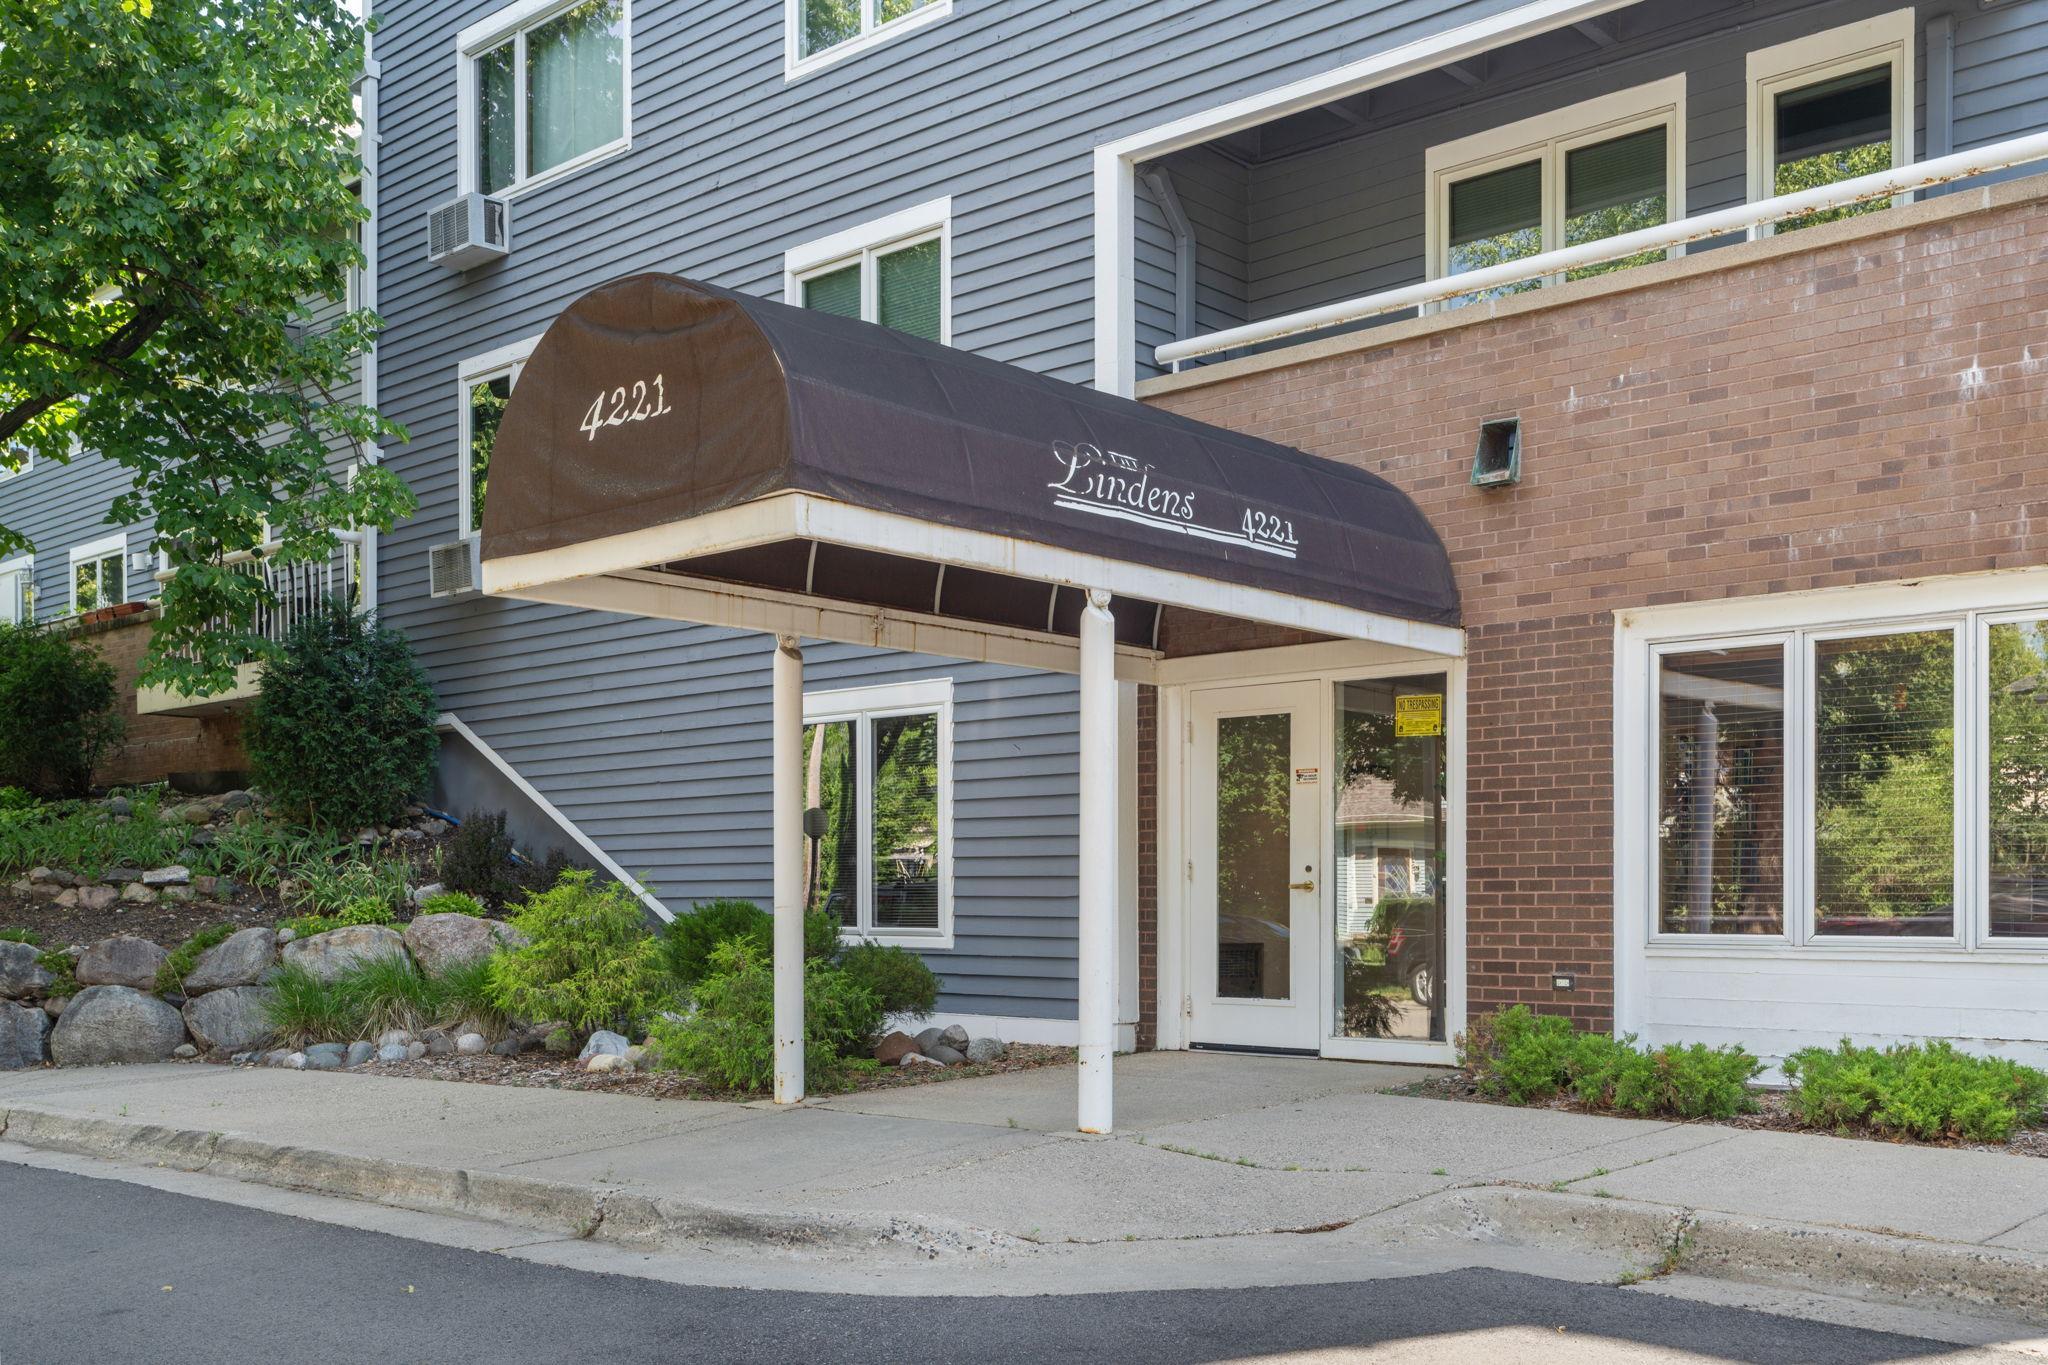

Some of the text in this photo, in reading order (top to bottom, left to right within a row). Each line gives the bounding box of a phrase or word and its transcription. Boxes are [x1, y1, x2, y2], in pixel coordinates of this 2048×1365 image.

[579, 373, 672, 441] 4221
[1047, 439, 1299, 545] Lindens 4221
[1398, 698, 1440, 711] NO TRESPASSING
